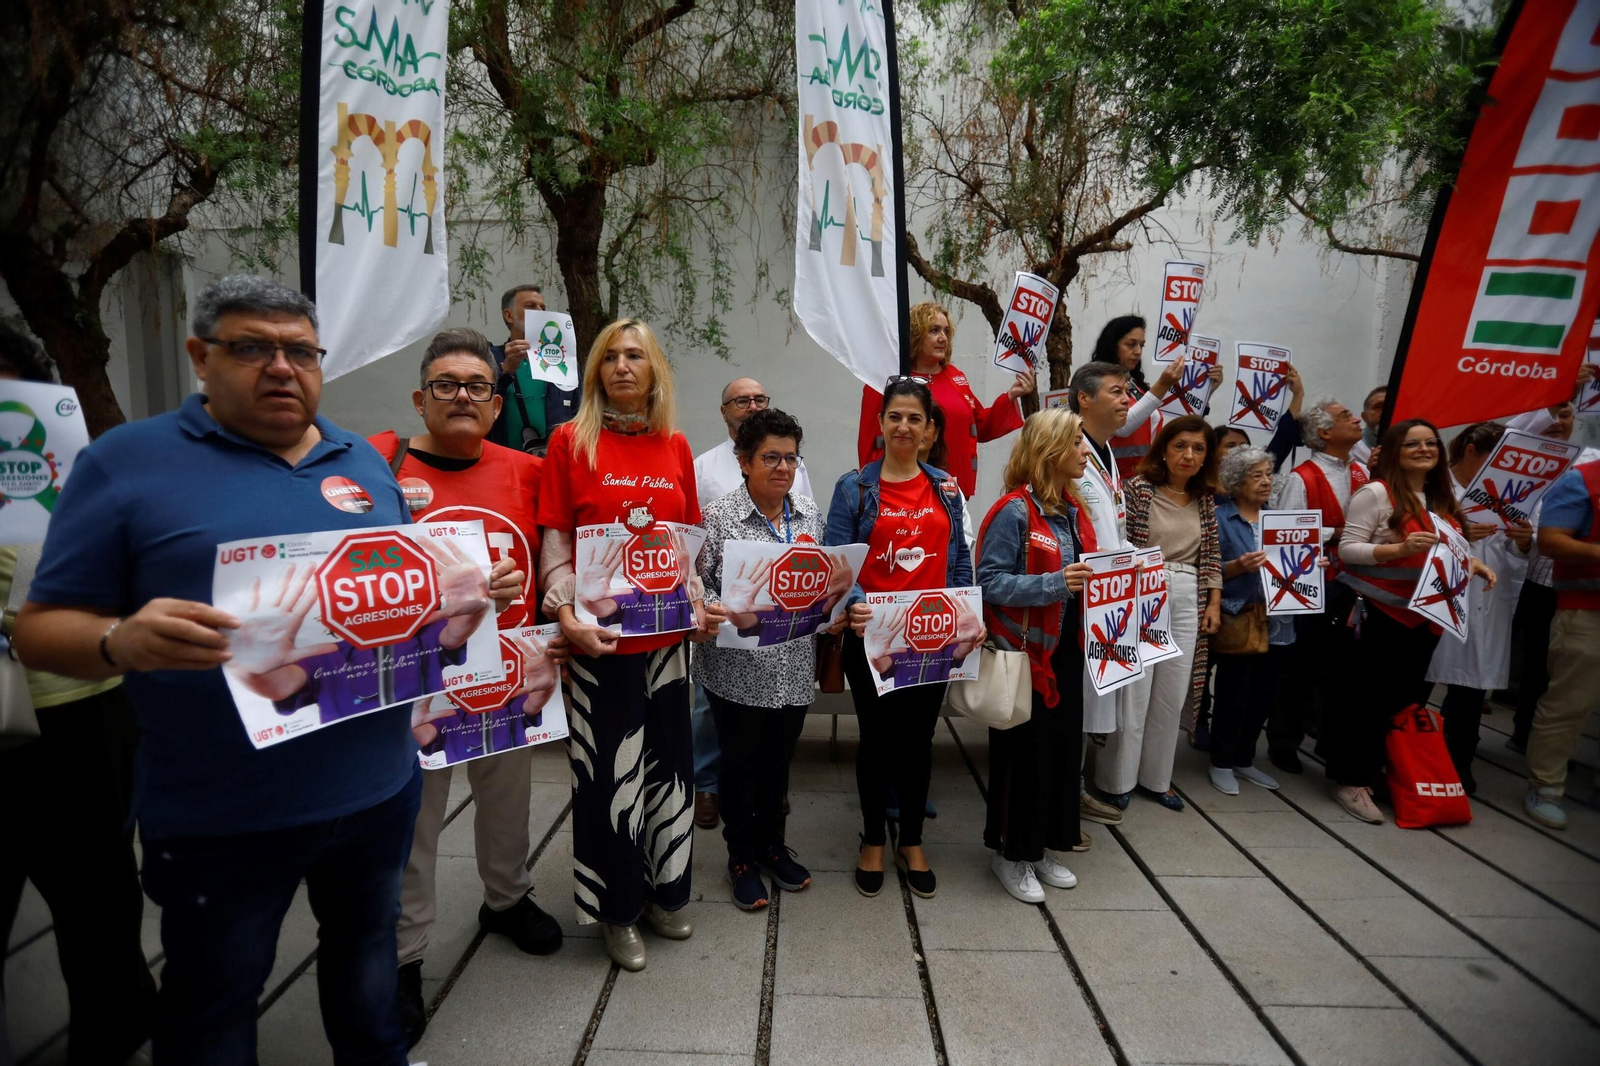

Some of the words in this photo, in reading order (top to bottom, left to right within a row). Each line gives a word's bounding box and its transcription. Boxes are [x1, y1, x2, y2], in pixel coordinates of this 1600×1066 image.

[334, 4, 441, 76] SMA
[342, 59, 440, 97] CÓRDOBA
[1017, 292, 1050, 319] STOP
[1023, 321, 1042, 347] NO
[1191, 346, 1209, 361] TOP
[1250, 357, 1279, 372] STOP
[1457, 356, 1557, 379] Córdoba
[1182, 362, 1210, 389] NO
[1253, 372, 1282, 403] NO
[1499, 450, 1560, 475] STOP
[402, 486, 430, 494] NETE
[602, 473, 638, 487] Sanidad
[641, 475, 674, 489] Pública
[325, 485, 363, 497] ÚNETE
[1500, 478, 1535, 504] NO
[429, 527, 448, 537] UGT
[579, 529, 595, 540] UGT
[641, 534, 668, 548] SAS
[1030, 531, 1051, 545] COO
[1275, 529, 1310, 543] STOP
[220, 546, 258, 565] UGT
[349, 546, 403, 572] SAS
[1447, 537, 1465, 562] STOP
[631, 548, 676, 571] STOP
[790, 557, 820, 570] SAS
[1279, 543, 1316, 580] NO
[635, 569, 679, 579] AGRESIONES
[778, 571, 827, 590] STOP
[1138, 569, 1166, 593] TOP
[334, 568, 425, 613] STOP
[779, 590, 820, 598] AGRESIONES
[1089, 573, 1132, 603] STOP
[869, 596, 887, 605] UGT
[921, 600, 943, 614] SAS
[343, 603, 424, 628] AGRESIONES
[1141, 597, 1161, 627] NO
[911, 613, 951, 634] STOP
[1105, 607, 1129, 644] NO
[912, 632, 949, 641] AGRESIONES
[1088, 640, 1138, 664] AGRESIONES
[444, 675, 464, 687] UGT
[460, 683, 513, 699] AGRESIONES
[253, 727, 274, 742] UGT
[526, 734, 542, 743] UGT
